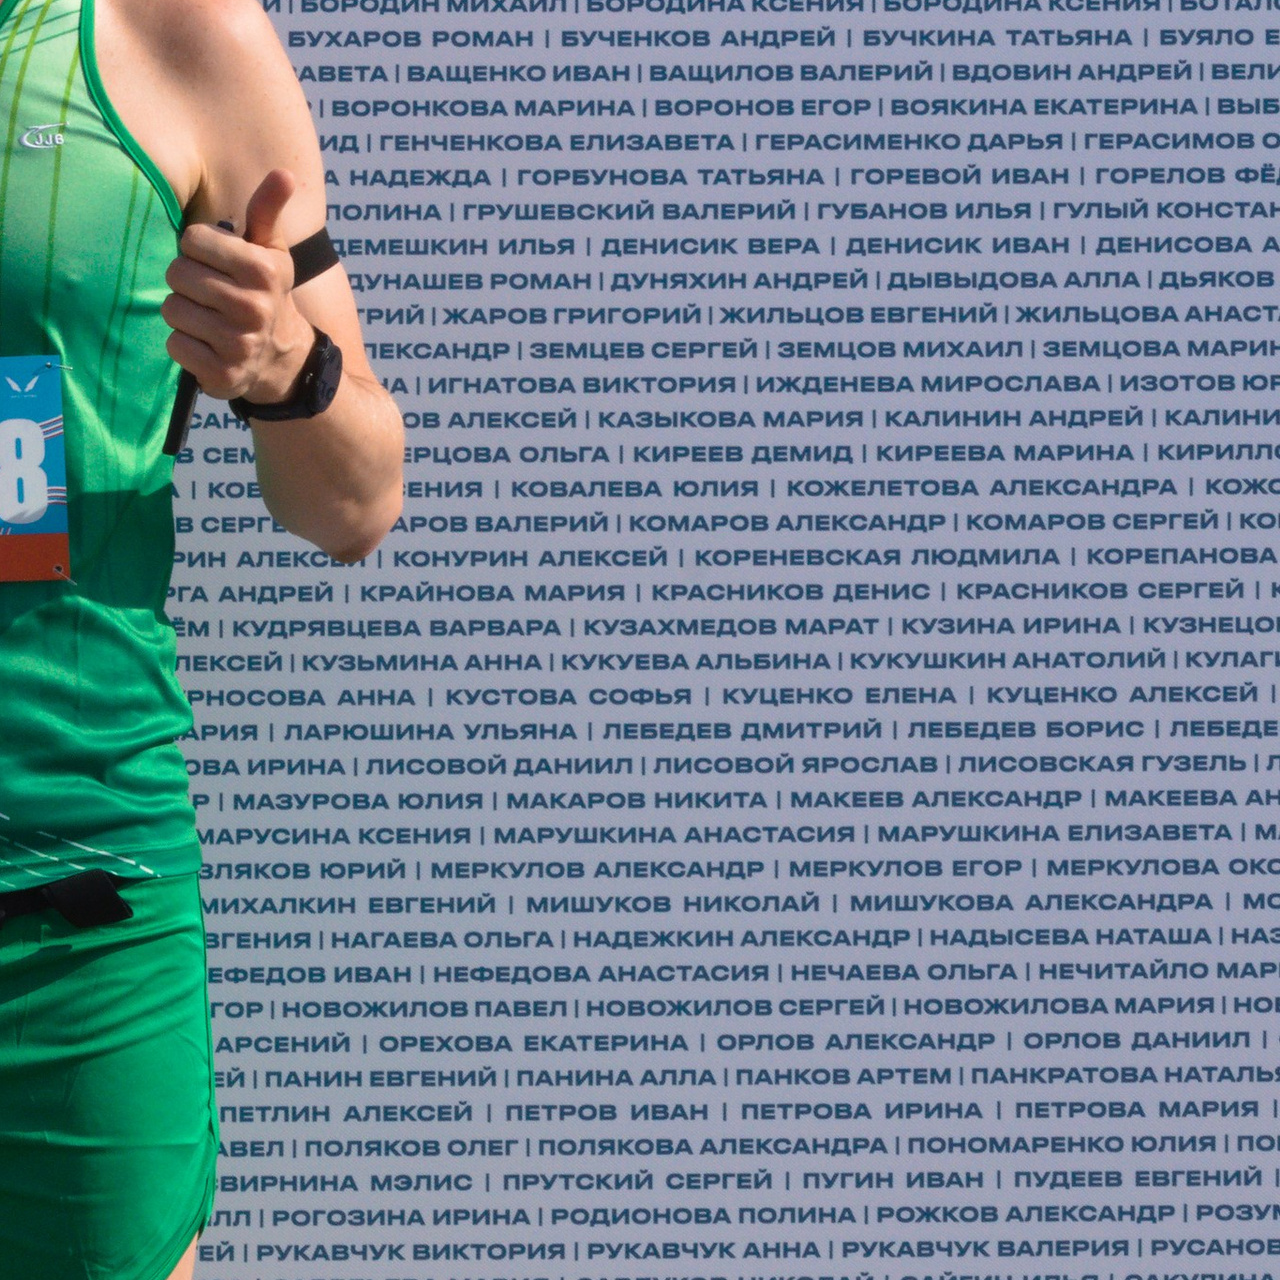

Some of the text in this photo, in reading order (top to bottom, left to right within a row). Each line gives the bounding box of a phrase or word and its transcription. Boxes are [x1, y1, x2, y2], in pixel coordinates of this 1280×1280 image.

[650, 61, 932, 83] ВАЩИЛОВ ВАЛЕРИЙ
[571, 134, 960, 150] ЕЛИЗАВЕТА ГЕРАСИМЕНКО
[464, 199, 795, 220] ГРУШЕВСКИЙ ВАЛЕРИЙ
[611, 273, 746, 291] ДУНЯХИН
[754, 268, 867, 291] АНДРЕЙ
[530, 338, 757, 360] ЗЕМЦЕВ СЕРГЕЙ
[599, 411, 863, 428] КАЗЫКОВА МАРИЯ
[512, 481, 758, 497] КОВАЛЕВА ЮЛИЯ
[539, 546, 900, 566] АЛЕКСЕЙ КОРЕНЕВСКАЯ
[585, 619, 879, 637] КУЗАХМЕДОВ МАРАТ
[447, 689, 691, 705] КУСТОВА СОФЬЯ
[654, 753, 937, 773] ЛИСОВОЙ ЯРОСЛАВ
[495, 826, 854, 843] МАРУШКИНА АНАСТАСИЯ
[527, 892, 819, 913] МИШУКОВ НИКОЛАЙ
[434, 966, 590, 984] НЕФЕДОВА
[598, 965, 768, 982] АНАСТАСИЯ
[717, 1033, 995, 1051] ОРЛОВ АЛЕКСАНДР
[742, 1103, 982, 1120] ПЕТРОВА ИРИНА
[504, 1169, 772, 1190] ПРУТСКИЙ СЕРГЕЙ
[588, 1242, 820, 1259] РУКАВЧУК АННА
